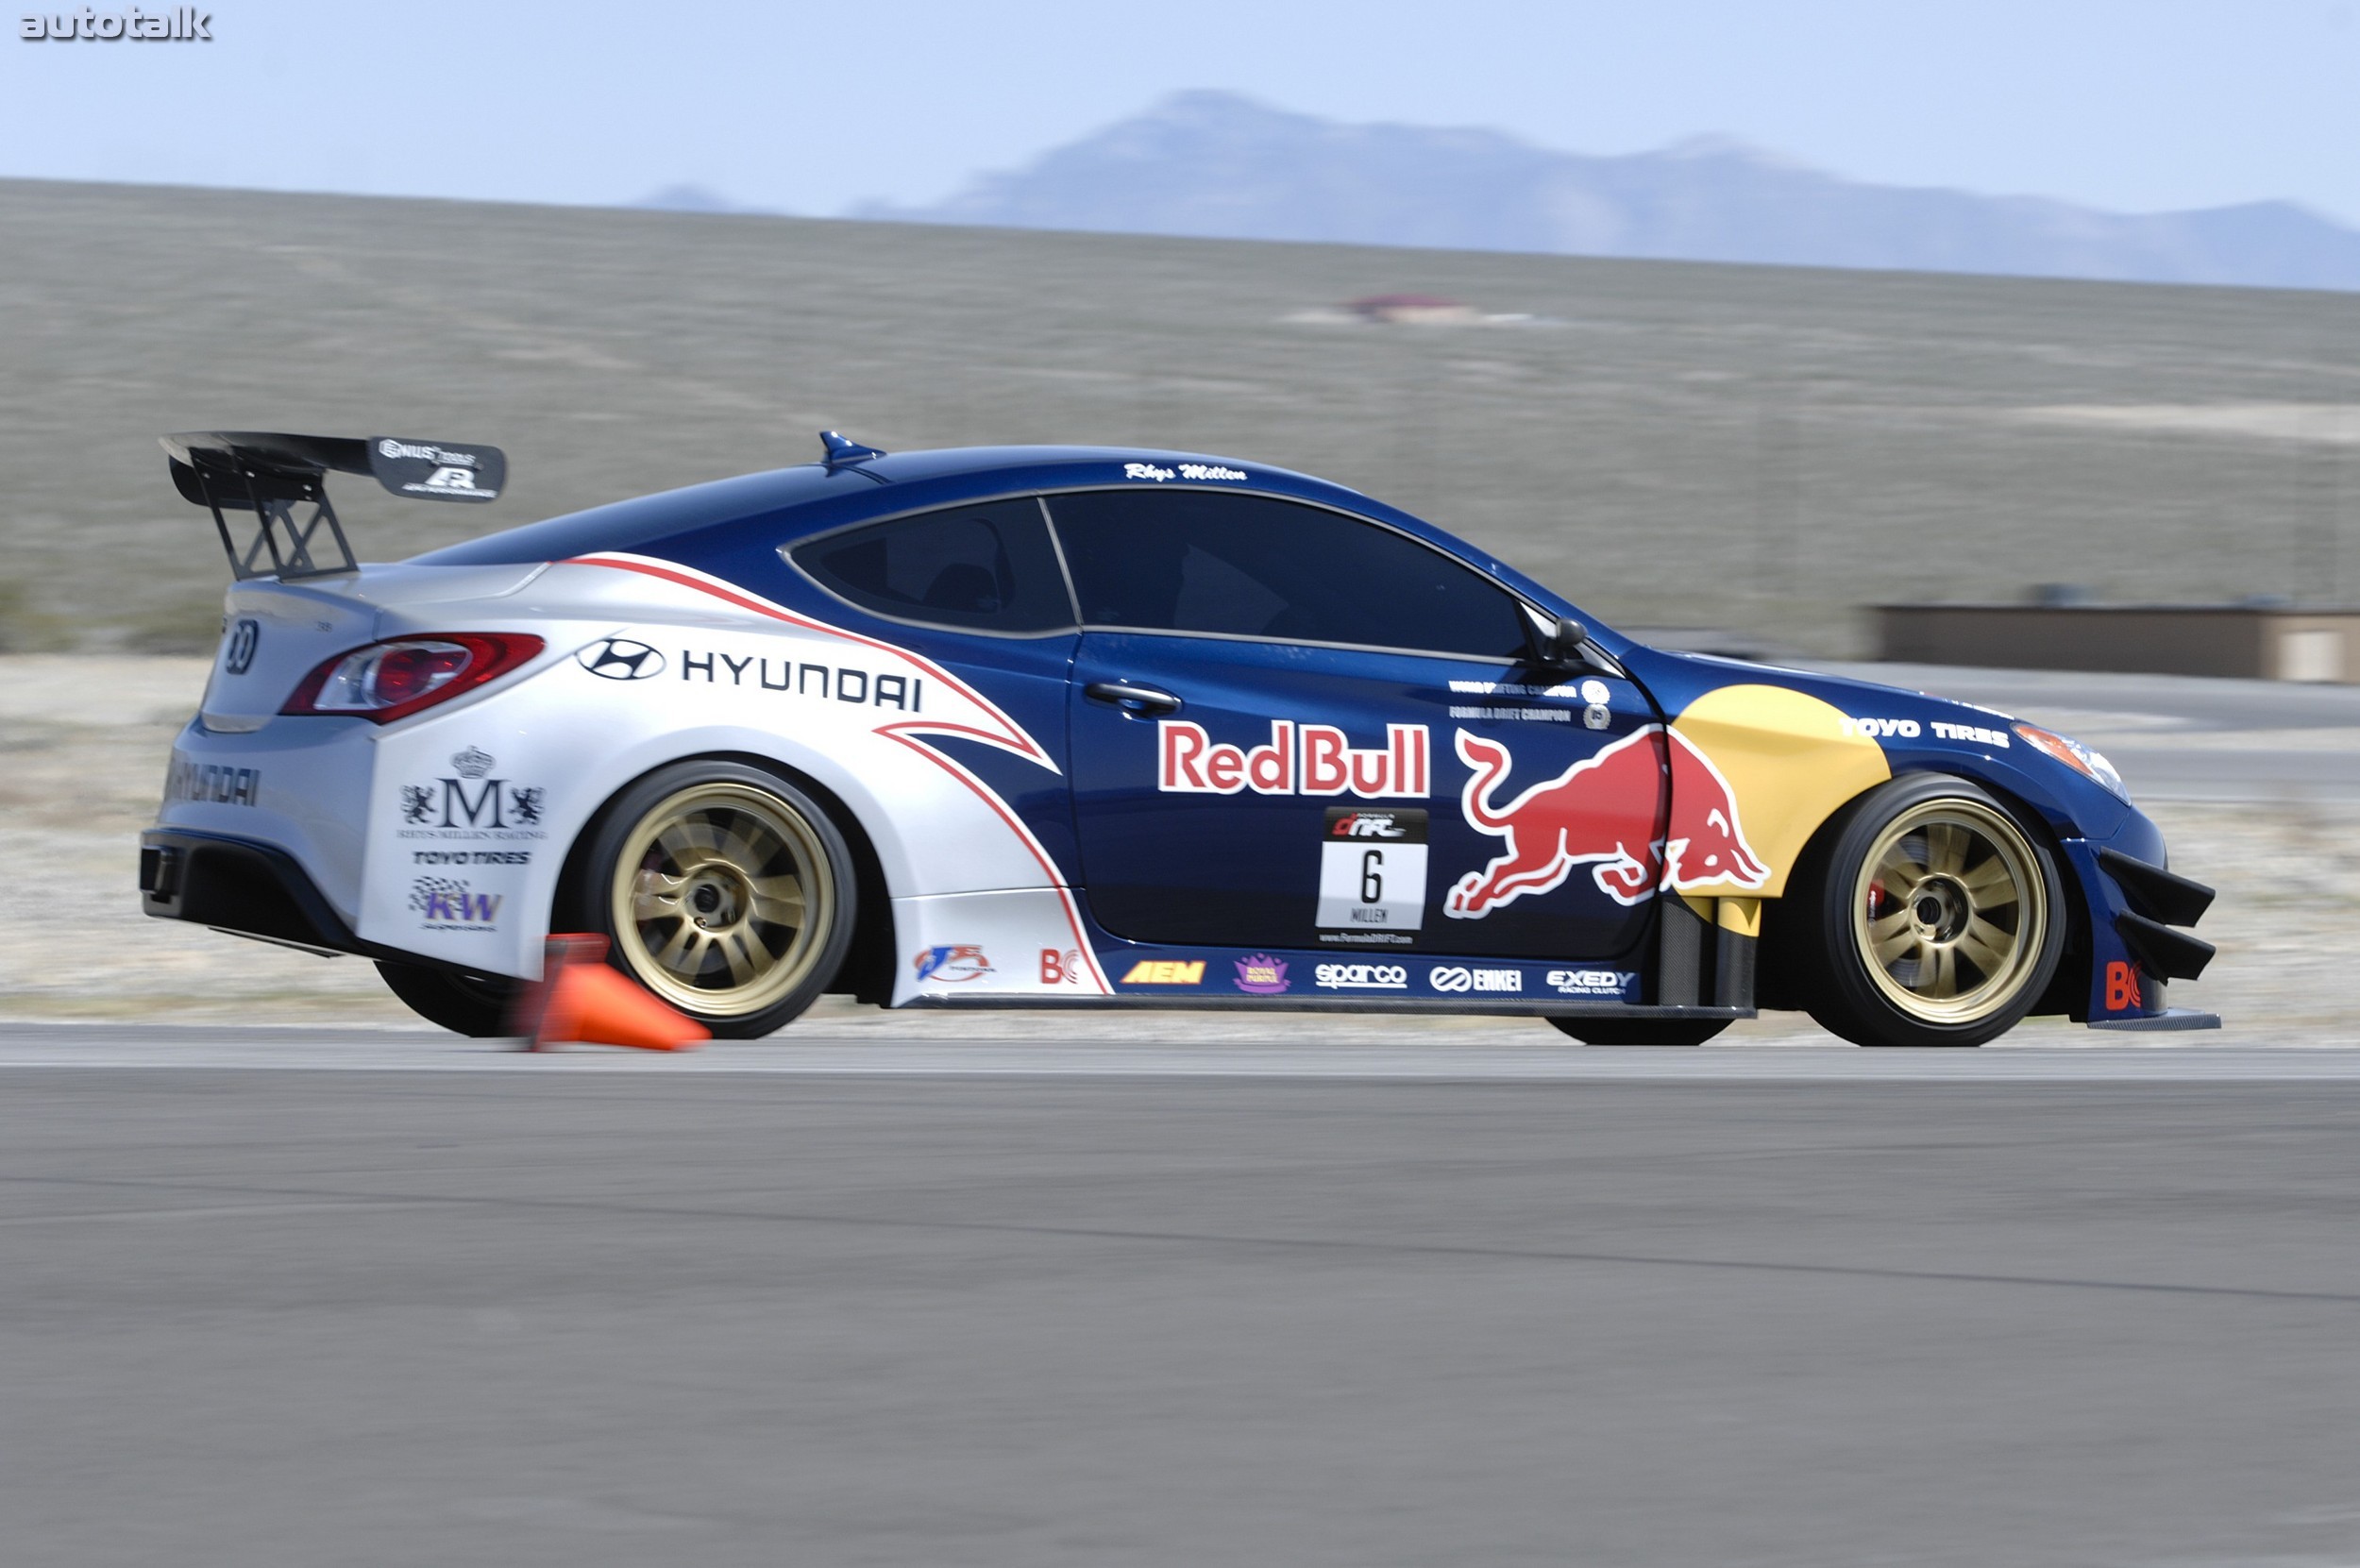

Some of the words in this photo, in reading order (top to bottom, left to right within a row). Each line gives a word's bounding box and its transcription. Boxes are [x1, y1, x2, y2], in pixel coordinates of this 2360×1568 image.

[1124, 464, 1176, 482] Rhys
[1178, 464, 1247, 481] Millen
[683, 649, 922, 713] HYUNDAI
[1521, 709, 1572, 722] CHAMPION
[1840, 717, 1921, 737] TOYO
[1930, 721, 2010, 749] TIRES
[1158, 719, 1295, 795] Red
[1299, 723, 1431, 799] Bull
[413, 851, 469, 865] TOYO
[472, 851, 531, 865] TIRES
[1361, 850, 1384, 903] 6
[426, 891, 504, 922] KW
[1351, 908, 1389, 923] MILLEN
[1120, 959, 1207, 985] AEM
[1315, 964, 1408, 989] sparco
[1473, 969, 1523, 991] ENKEI
[1546, 969, 1636, 987] EXEDY
